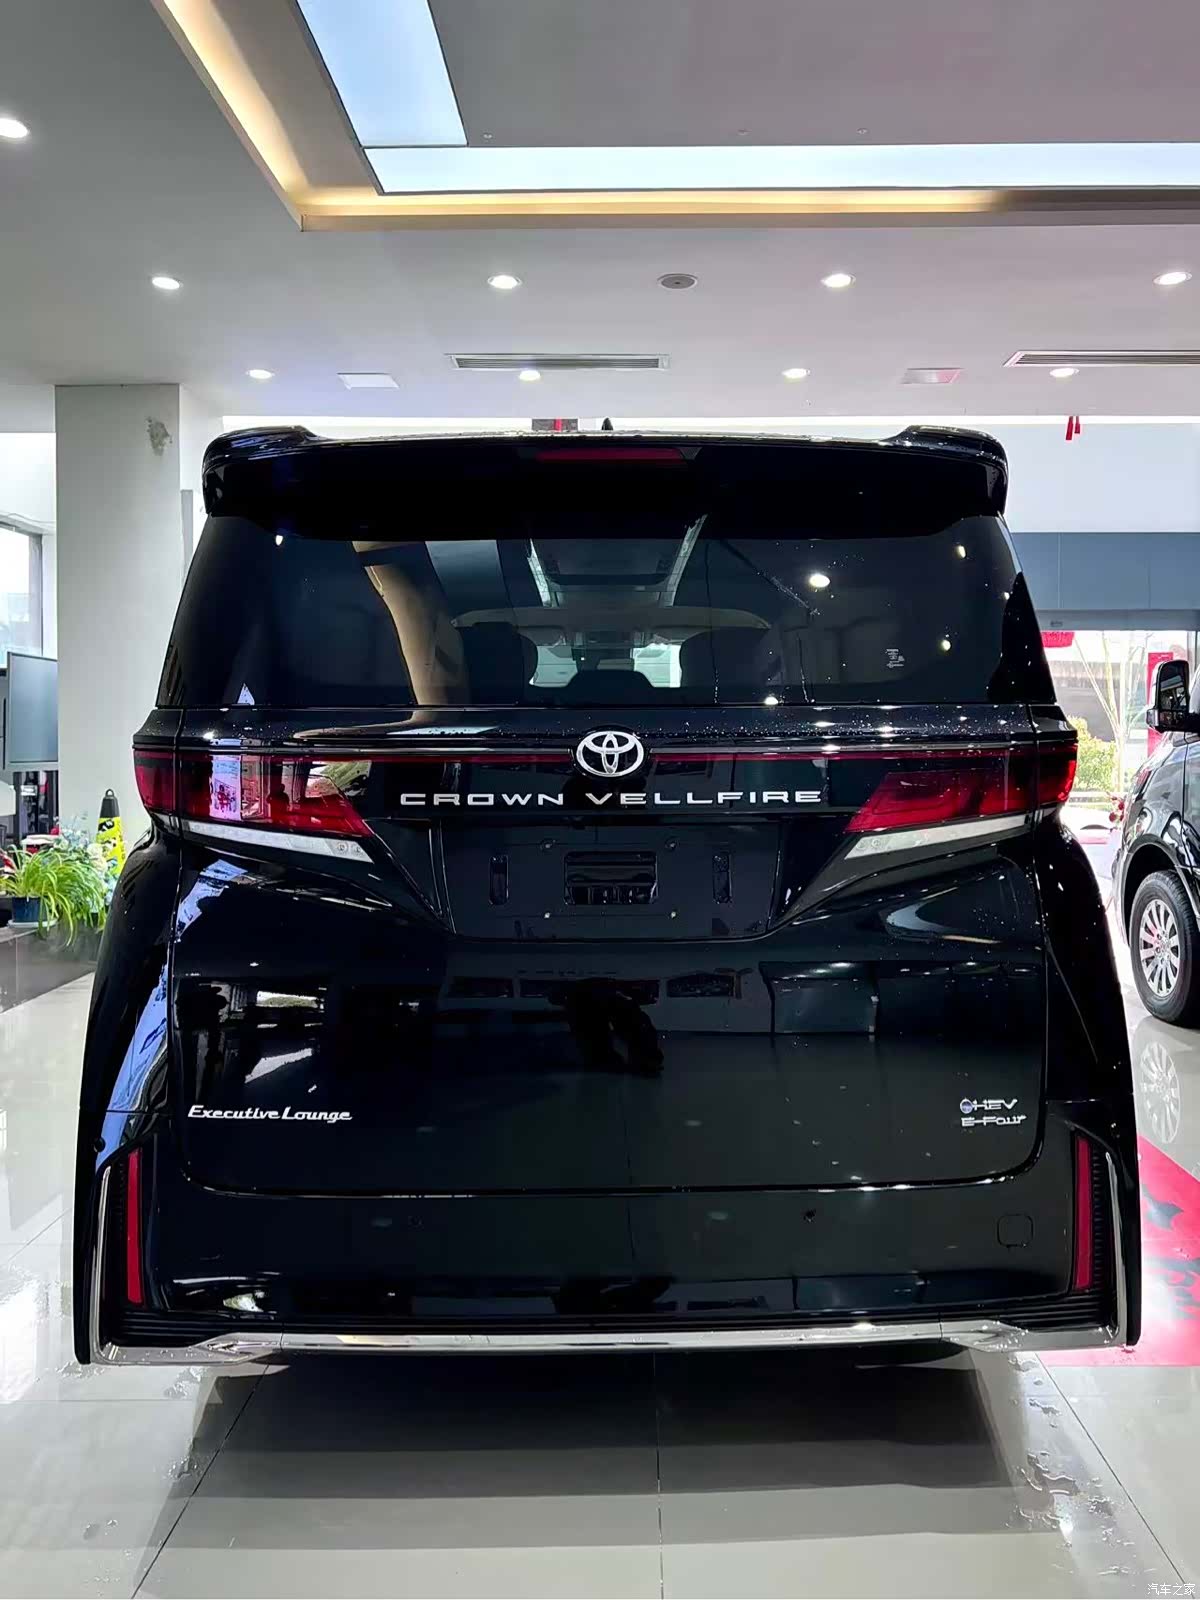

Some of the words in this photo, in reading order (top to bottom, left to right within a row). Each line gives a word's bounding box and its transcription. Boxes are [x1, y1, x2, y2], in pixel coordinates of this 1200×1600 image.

[400, 793, 564, 806] CROWN
[585, 790, 822, 805] VELLFIRE
[973, 1098, 1018, 1111] HEV
[187, 1104, 280, 1120] Executive
[281, 1106, 353, 1124] Lounge
